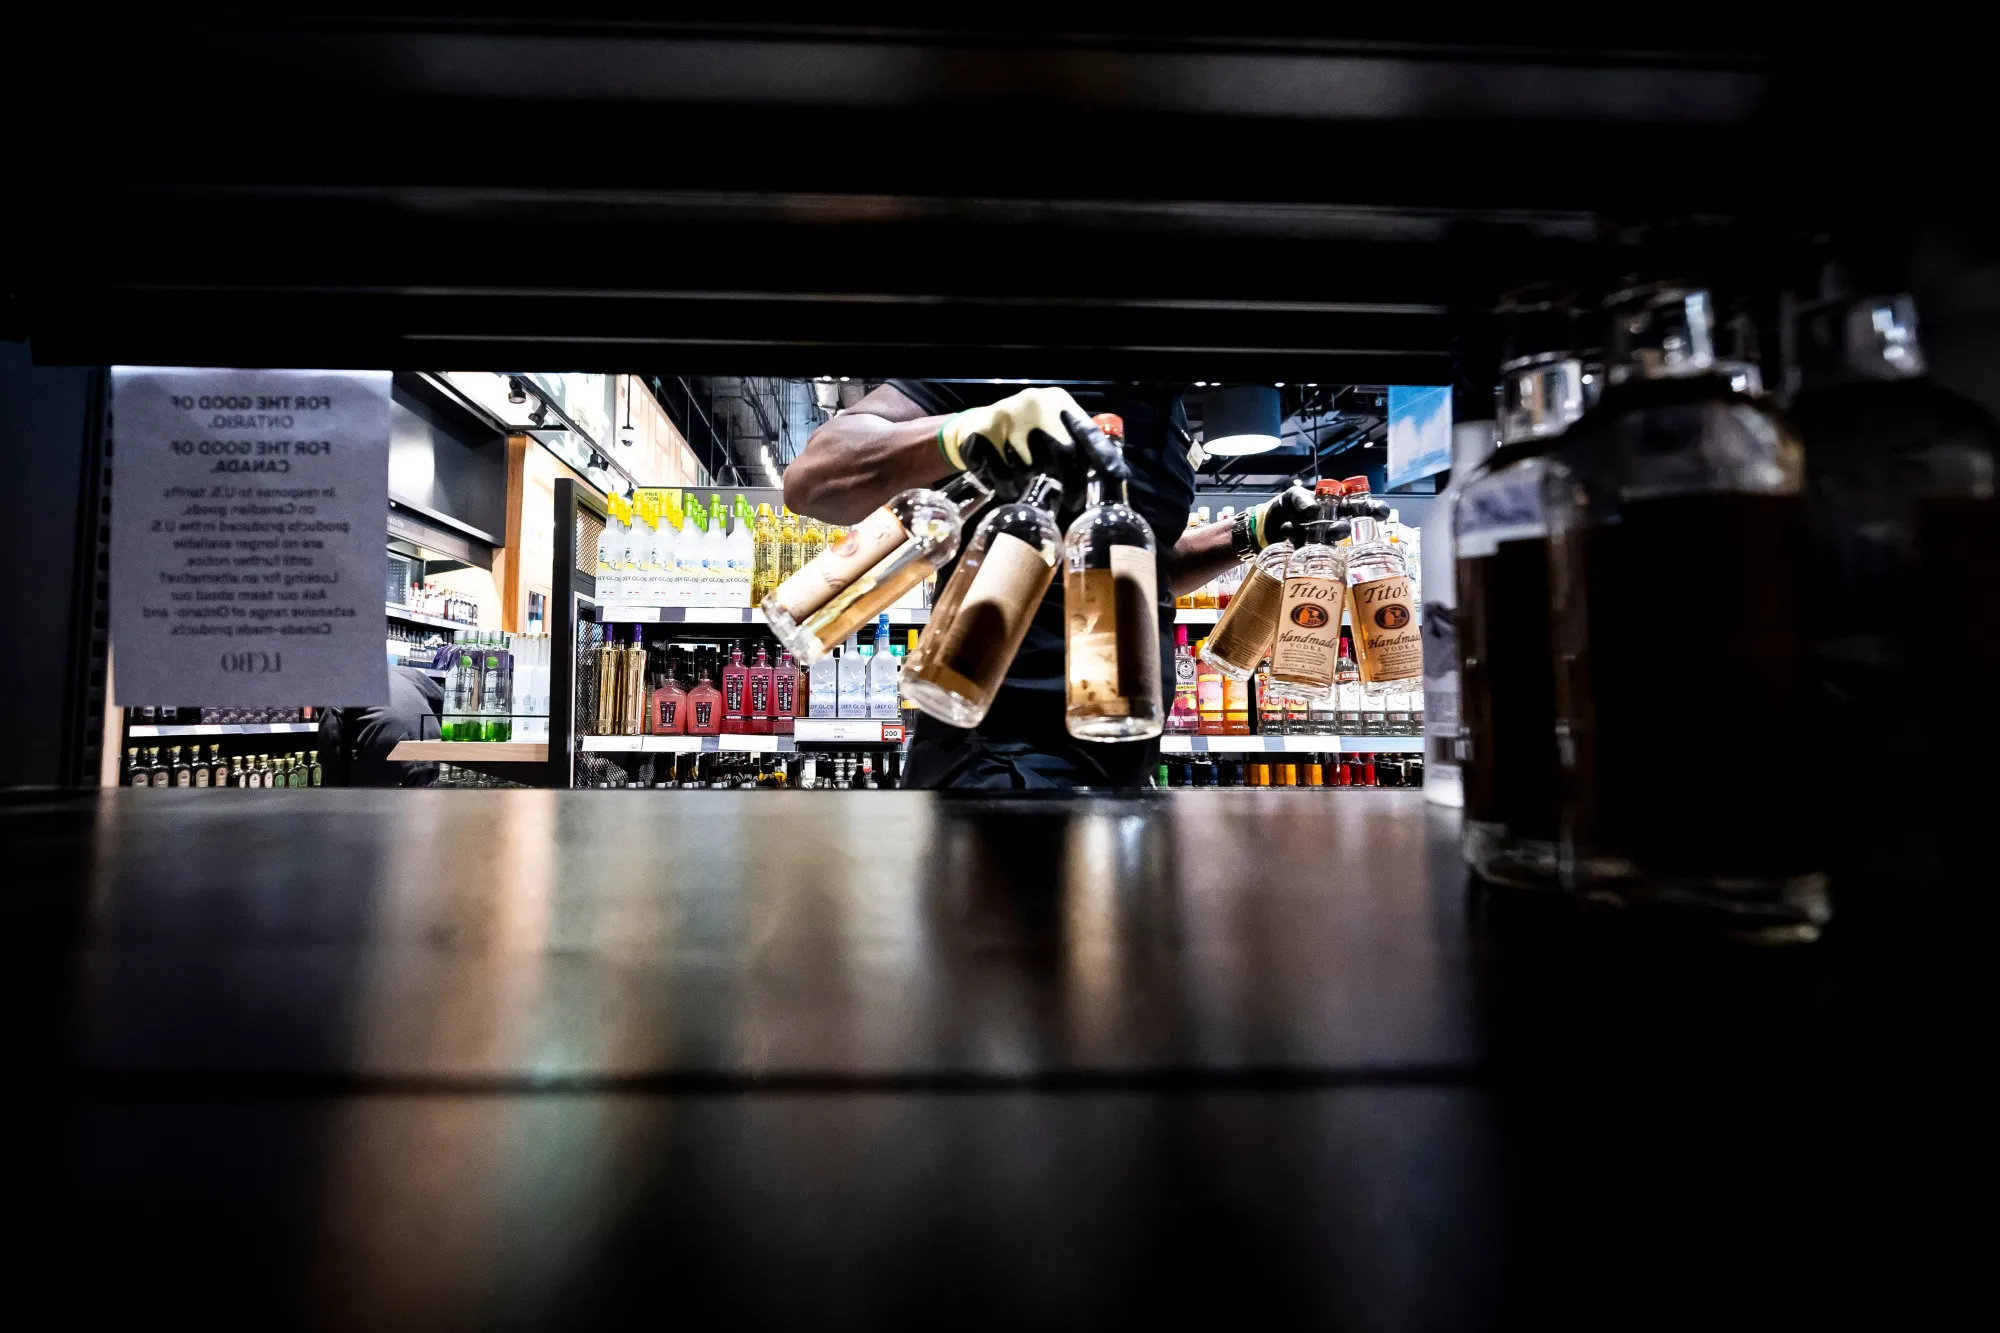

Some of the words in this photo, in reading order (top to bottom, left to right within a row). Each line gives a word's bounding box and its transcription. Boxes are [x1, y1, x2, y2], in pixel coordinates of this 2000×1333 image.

[1290, 582, 1337, 602] Tito's
[1364, 582, 1408, 603] Tito's
[1279, 630, 1336, 649] Handmade
[1290, 643, 1322, 652] VODKA
